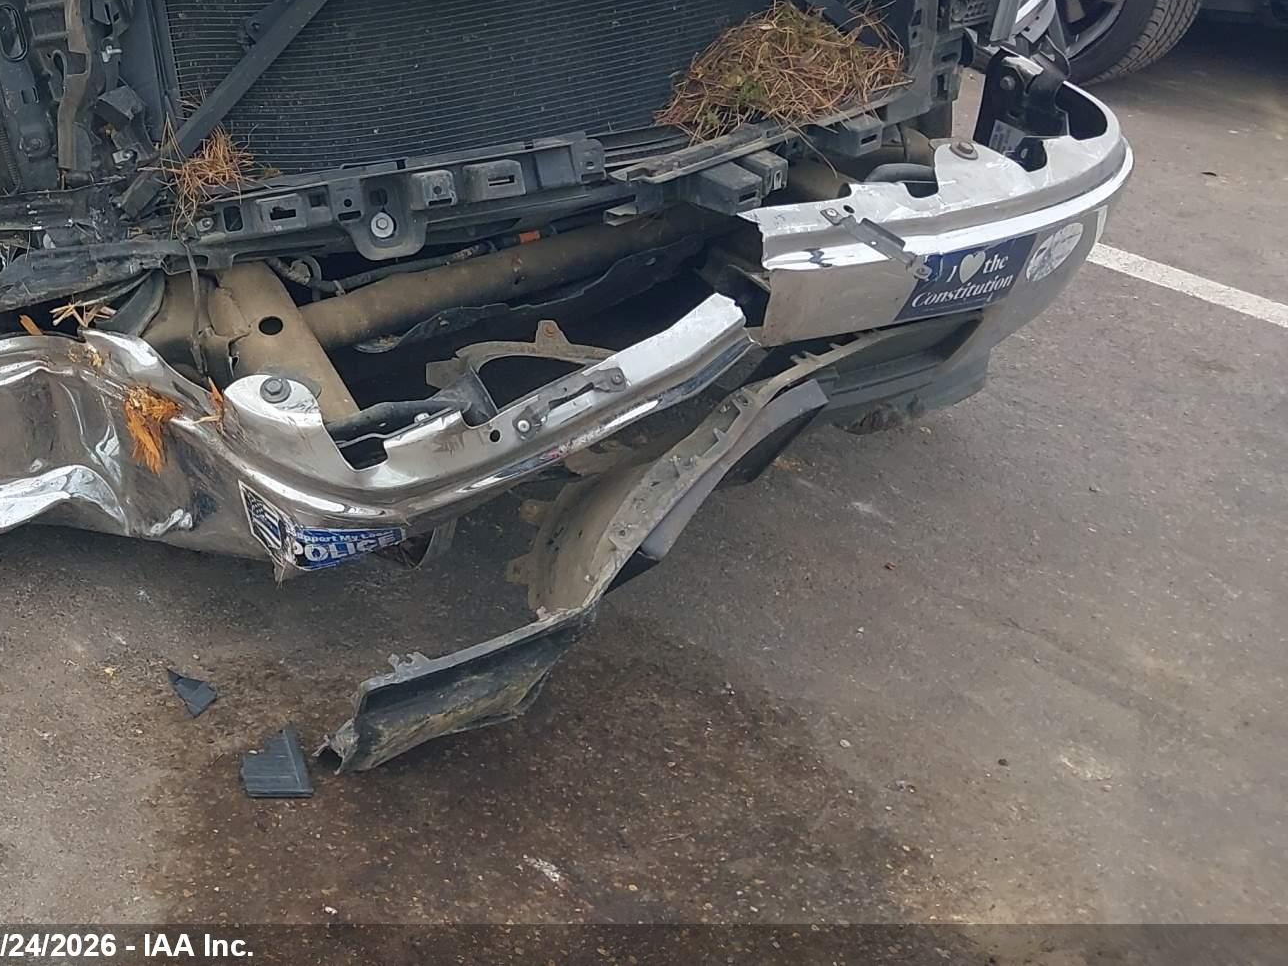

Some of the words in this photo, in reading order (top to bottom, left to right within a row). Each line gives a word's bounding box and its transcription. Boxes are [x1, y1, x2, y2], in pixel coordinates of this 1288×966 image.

[946, 265, 957, 283] I
[982, 253, 1009, 275] the
[911, 274, 1014, 308] Constitution
[292, 534, 396, 561] POLICE
[296, 533, 337, 543] upport
